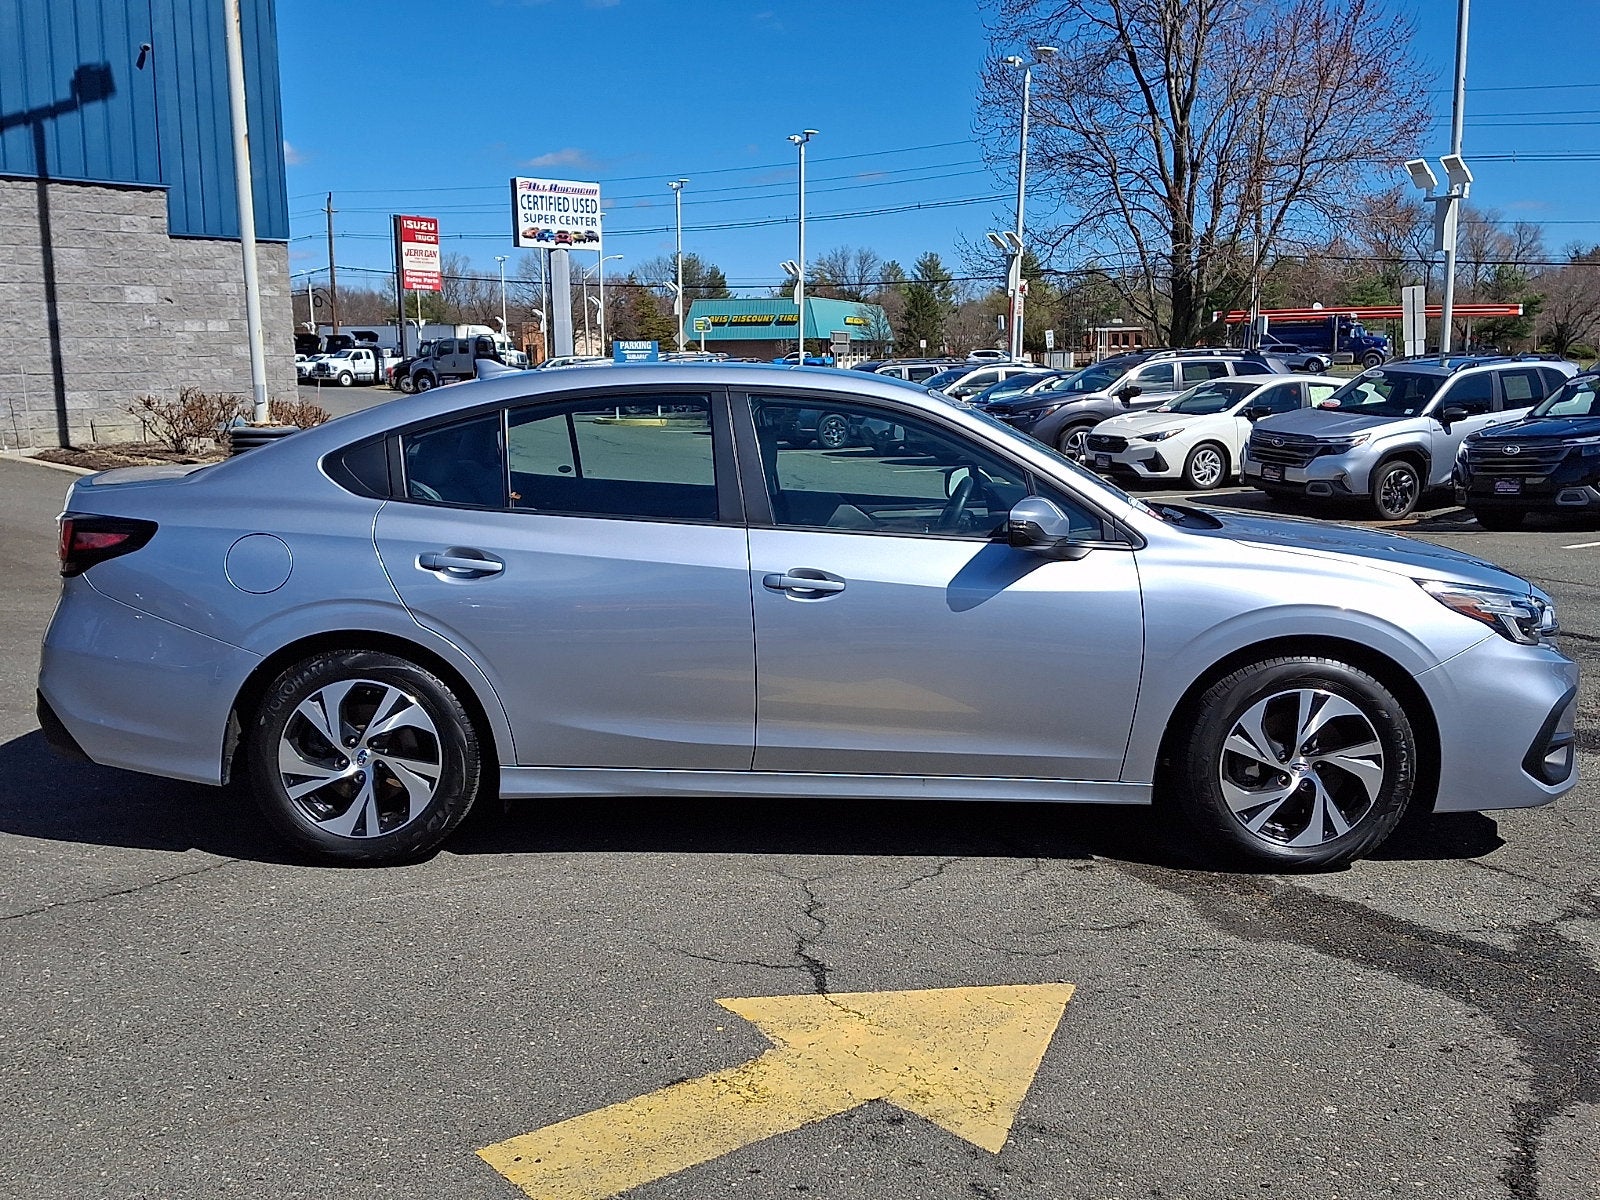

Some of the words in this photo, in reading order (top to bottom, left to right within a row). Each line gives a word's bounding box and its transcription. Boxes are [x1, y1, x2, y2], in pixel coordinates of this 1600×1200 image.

[520, 194, 570, 213] CERTIFIED
[572, 197, 598, 214] USED
[523, 213, 556, 225] SUPER
[558, 215, 598, 227] CENTER
[403, 219, 435, 231] ISUZU
[415, 234, 436, 242] TRUCK
[405, 270, 438, 278] Commercial
[412, 282, 434, 290] Service
[731, 314, 775, 323] DISCOUNT
[779, 314, 799, 322] TIRE
[620, 341, 652, 350] PARKING
